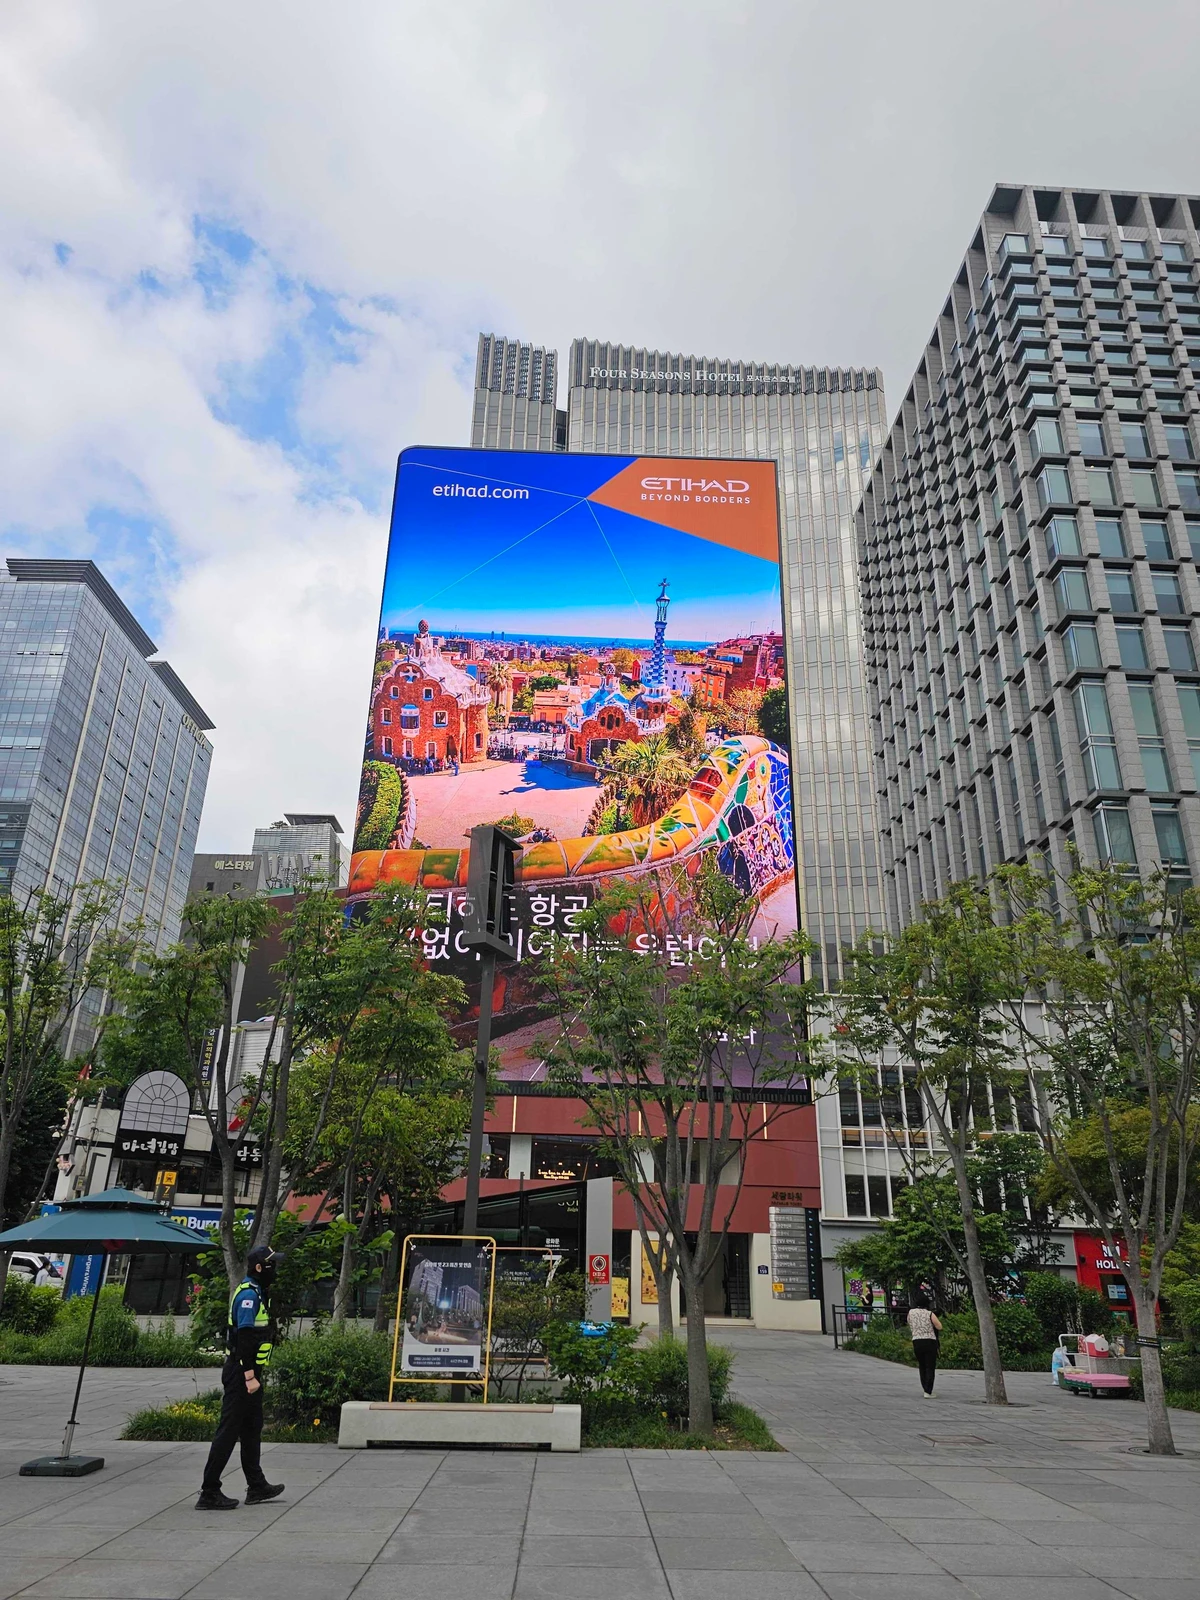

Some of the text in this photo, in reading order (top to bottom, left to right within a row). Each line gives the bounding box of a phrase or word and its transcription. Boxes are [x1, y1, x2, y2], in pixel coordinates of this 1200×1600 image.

[589, 367, 744, 382] FOUR SEASONS HOTEL
[433, 484, 529, 499] etihad.com
[641, 477, 750, 493] ETIHAD
[641, 494, 751, 504] BEYOND BORDERS
[214, 860, 254, 871] 에스타워
[122, 1138, 179, 1156] 마녀김밥
